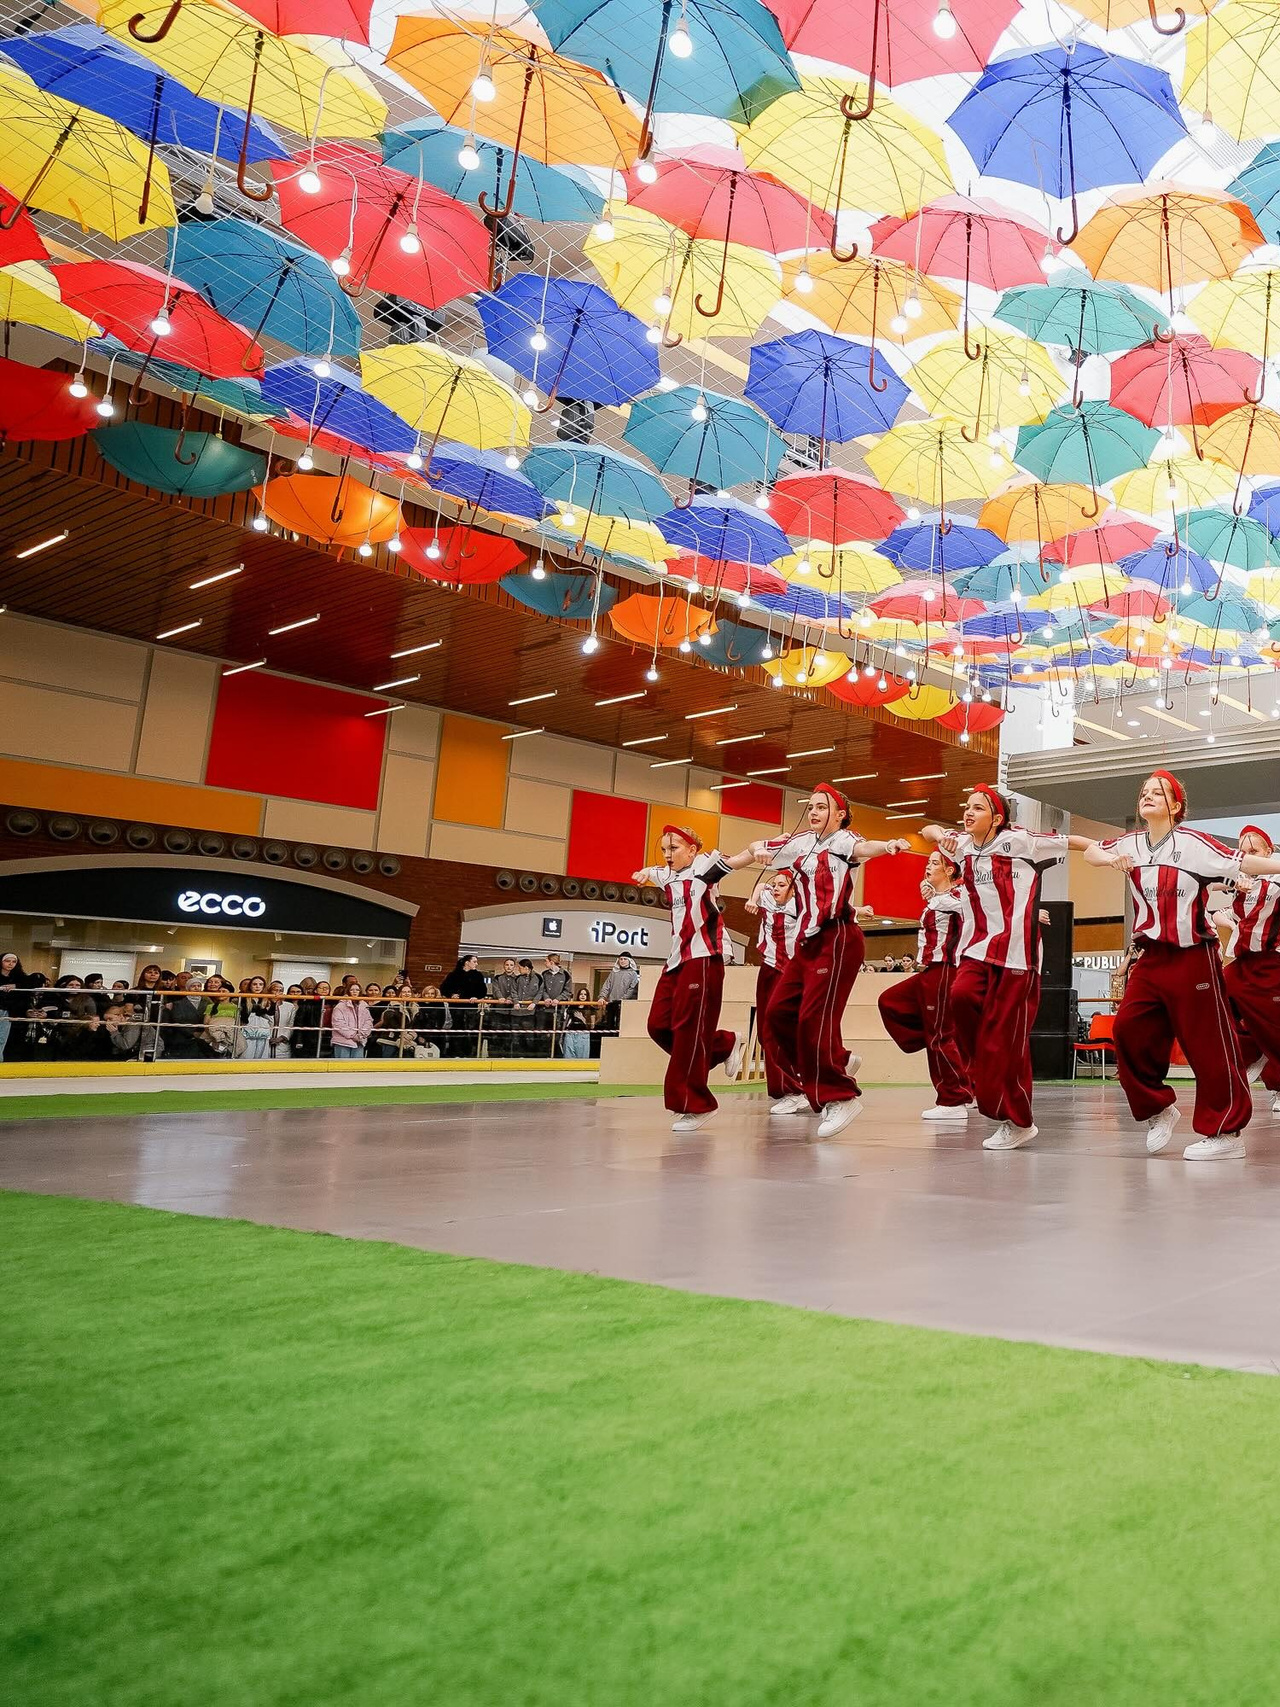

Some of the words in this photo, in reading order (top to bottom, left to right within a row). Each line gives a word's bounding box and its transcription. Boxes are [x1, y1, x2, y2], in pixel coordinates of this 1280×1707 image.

[178, 891, 266, 917] ecco
[591, 921, 649, 946] iPort
[1072, 956, 1124, 969] PUBLI
